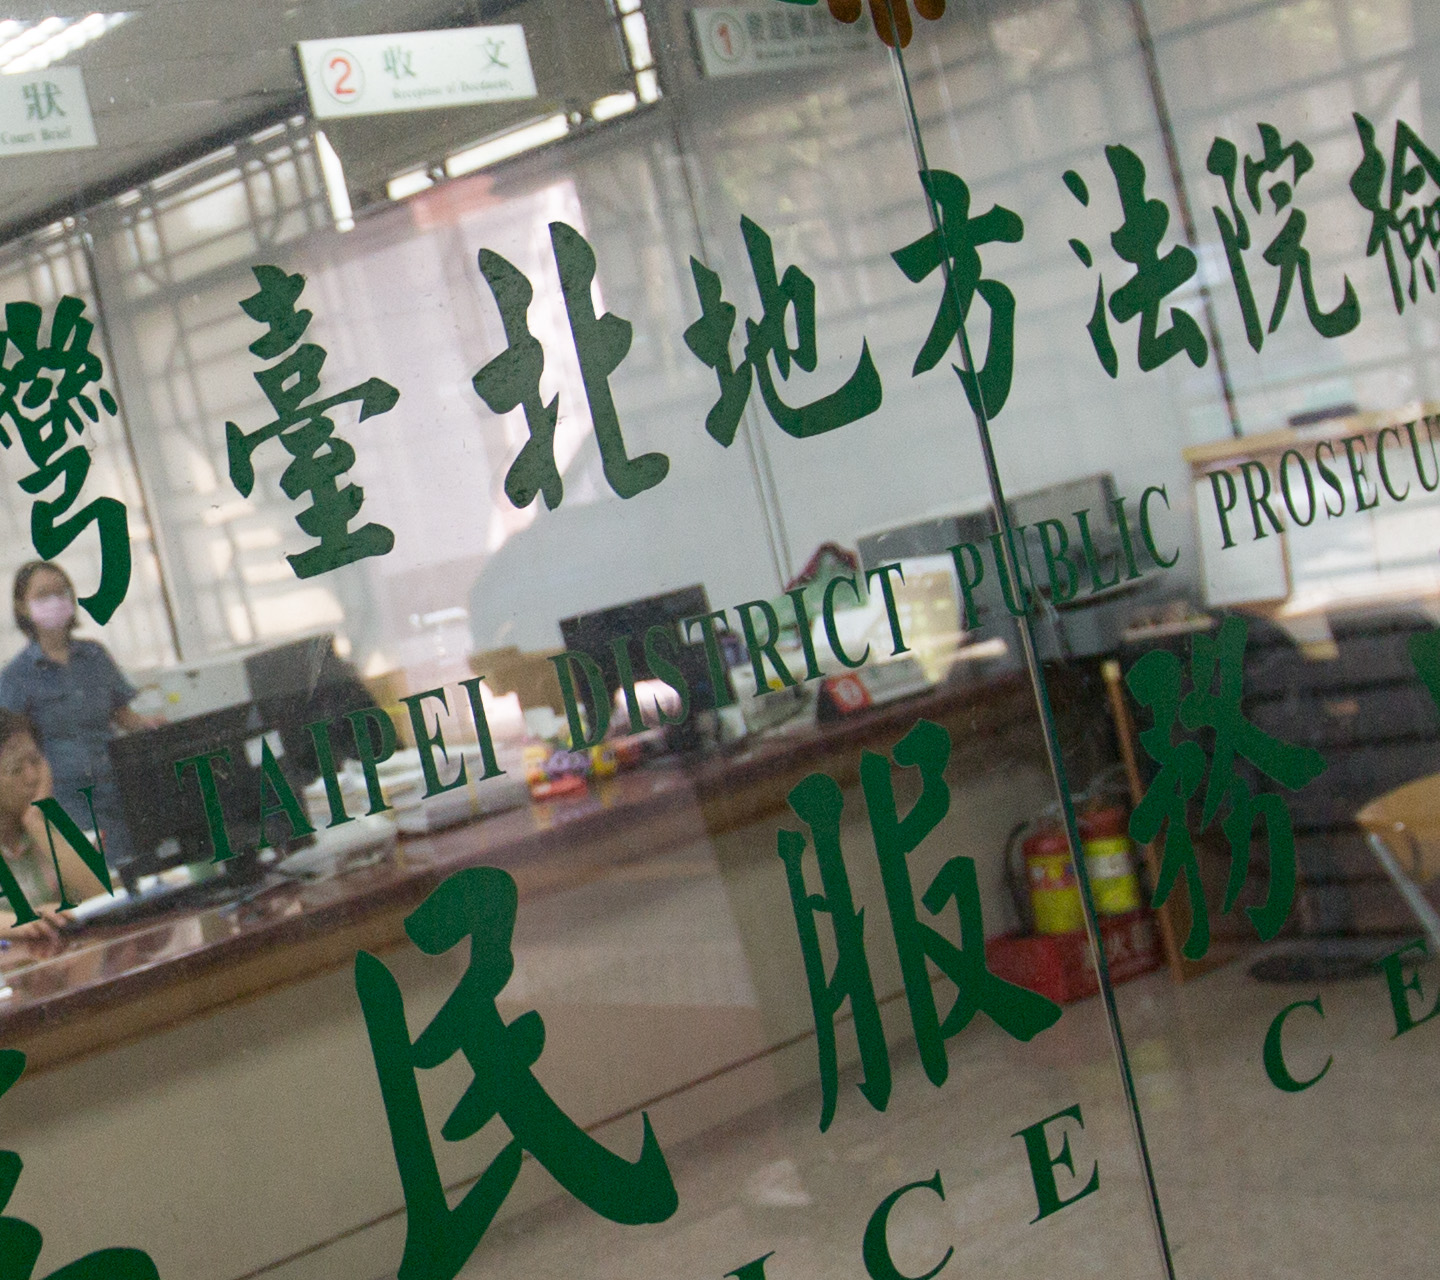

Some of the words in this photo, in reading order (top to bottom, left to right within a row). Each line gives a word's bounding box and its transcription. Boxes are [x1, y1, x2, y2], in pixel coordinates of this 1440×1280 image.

[329, 55, 357, 96] 2
[174, 674, 508, 866] TAIPEI
[546, 561, 912, 753] DISTRICT
[951, 483, 1182, 632] PUBLIC
